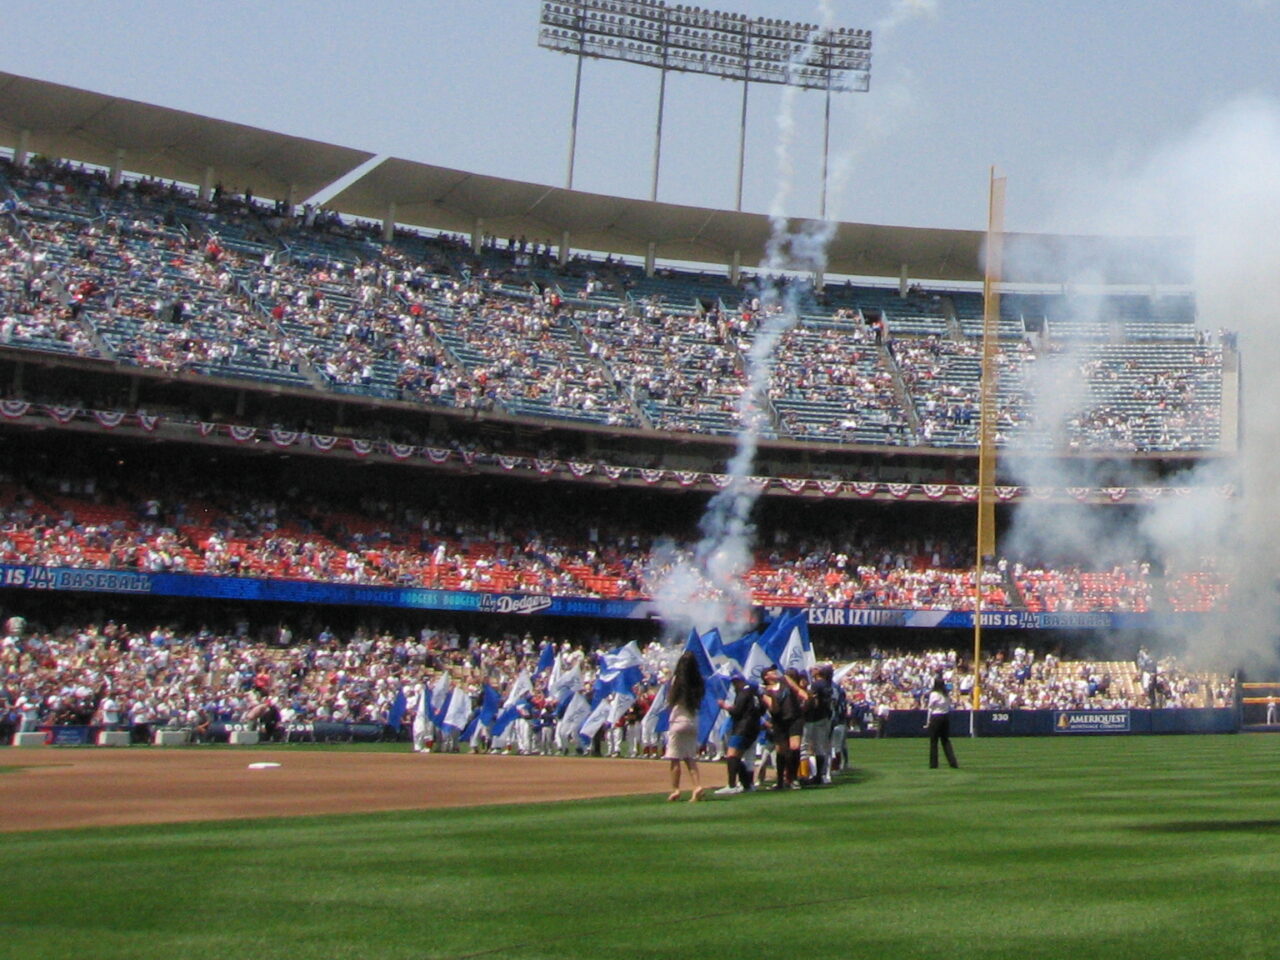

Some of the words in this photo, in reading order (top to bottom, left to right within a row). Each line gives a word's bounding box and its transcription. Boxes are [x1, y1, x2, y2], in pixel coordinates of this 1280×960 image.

[6, 568, 26, 585] IS
[60, 572, 152, 591] BASEBALL
[497, 595, 551, 614] Dodgers
[970, 612, 1001, 627] THIS
[1005, 614, 1018, 627] IS
[992, 713, 1009, 721] 330
[1070, 714, 1127, 725] AMERIQUEST
